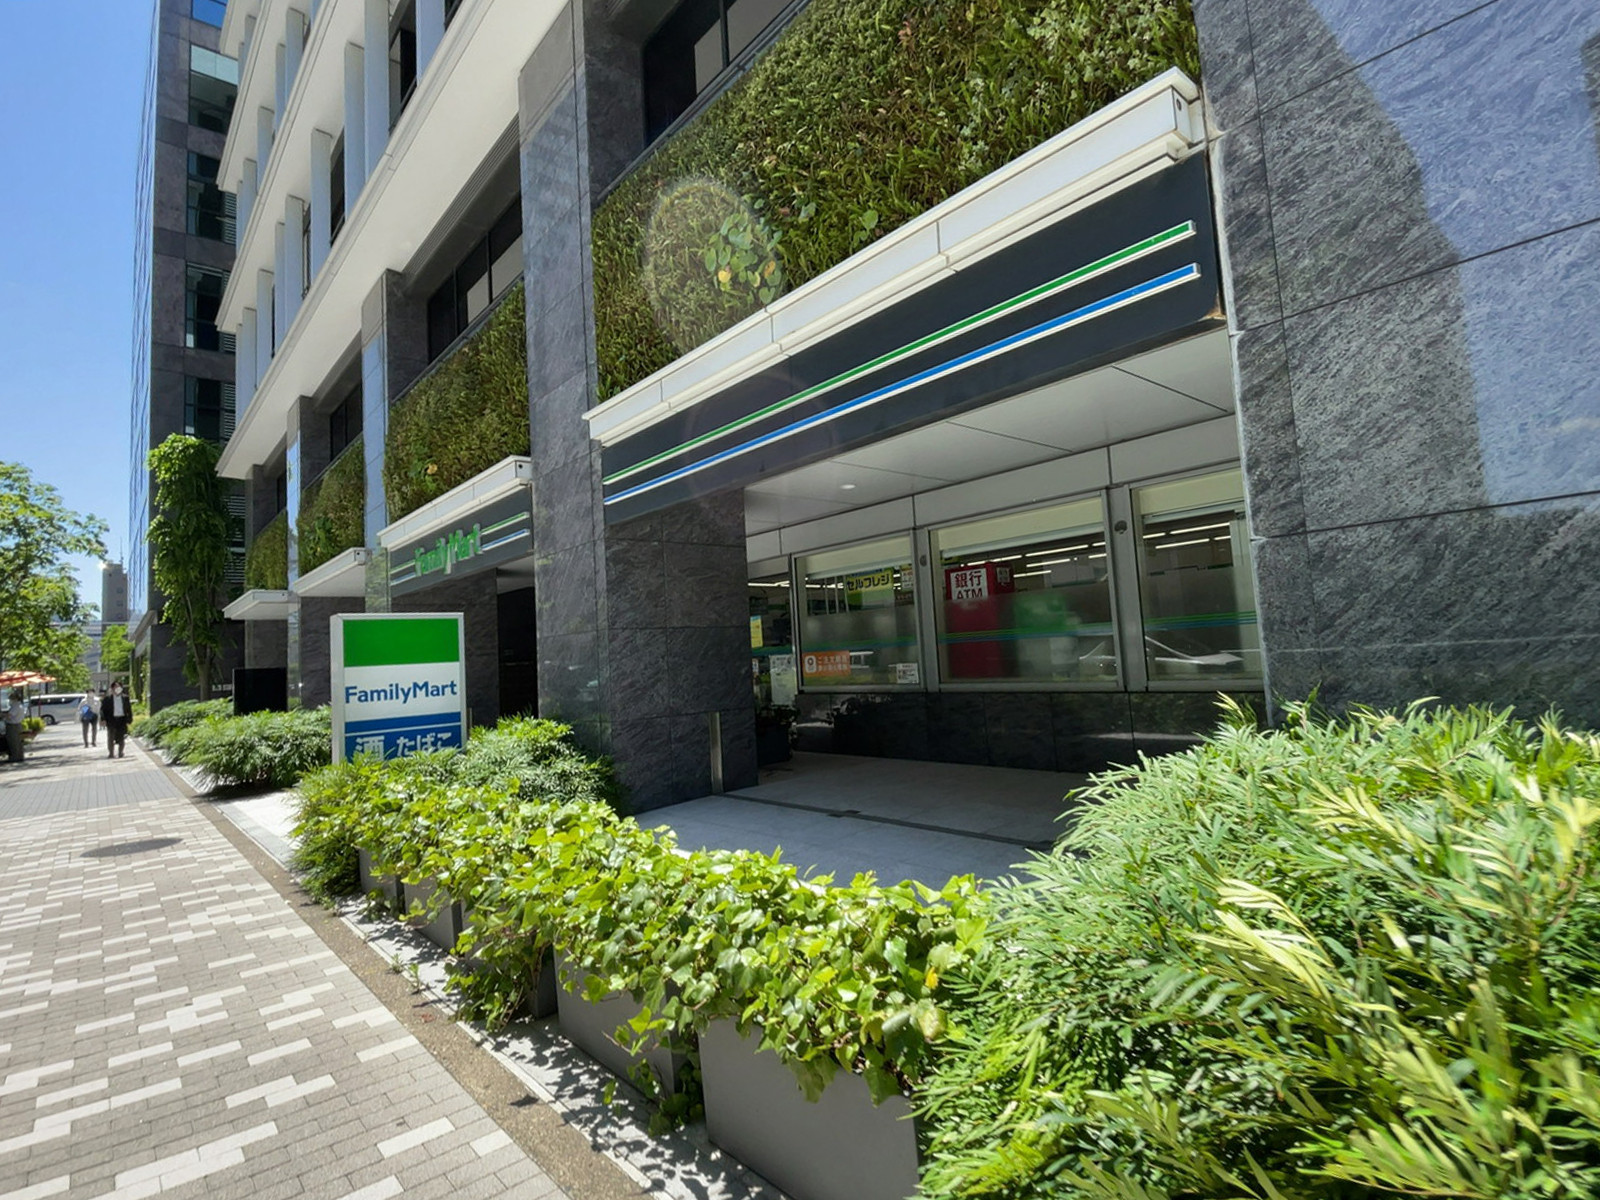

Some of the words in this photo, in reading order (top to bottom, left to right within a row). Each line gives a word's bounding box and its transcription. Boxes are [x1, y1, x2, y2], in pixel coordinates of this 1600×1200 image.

[415, 523, 482, 575] FamilyMart
[846, 573, 890, 591] セルフレジ
[954, 570, 982, 588] 銀行
[957, 588, 983, 600] ATM
[345, 680, 457, 704] FamilyMart
